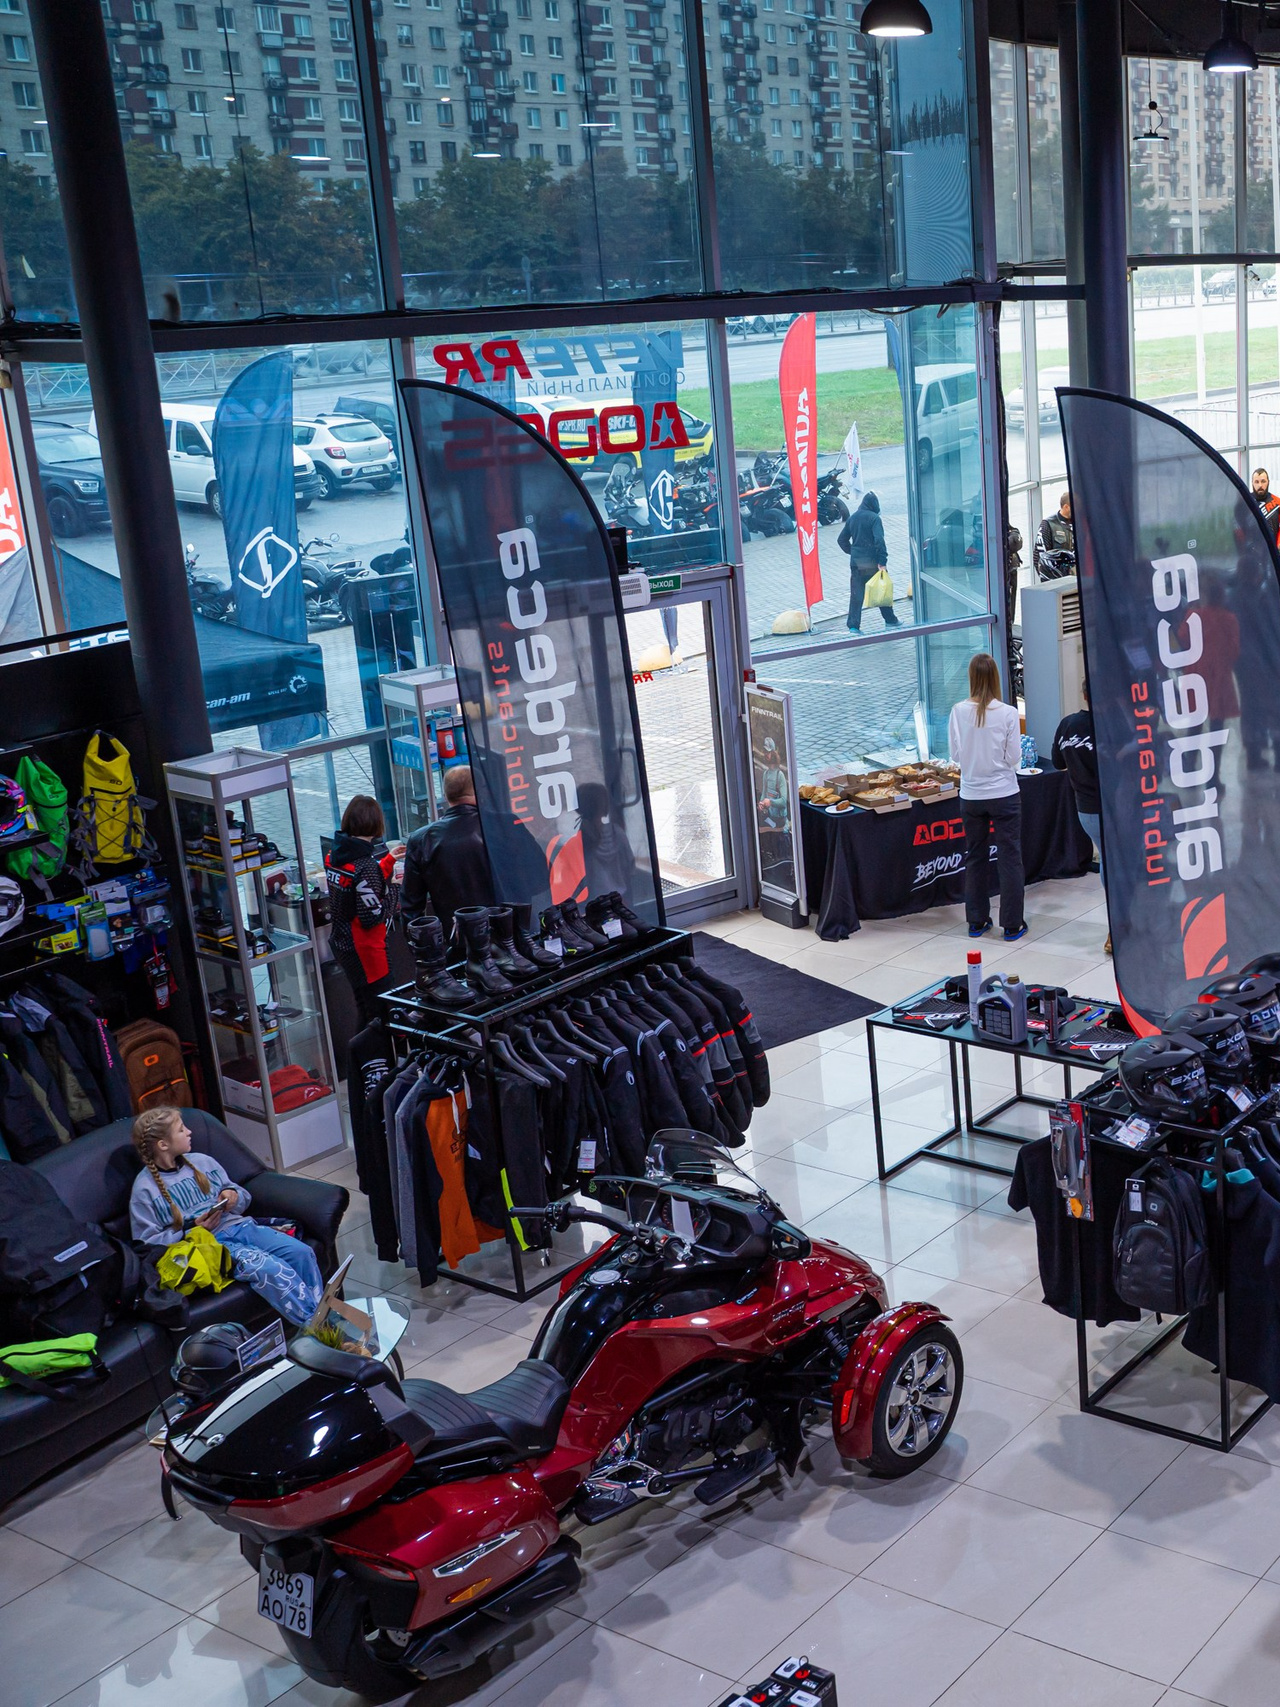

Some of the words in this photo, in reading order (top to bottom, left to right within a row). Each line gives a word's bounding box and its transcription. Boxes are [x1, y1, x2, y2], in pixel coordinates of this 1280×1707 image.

[751, 706, 784, 721] FINNTRAIL
[913, 853, 964, 884] BEYOND
[266, 1567, 305, 1598] 3869
[287, 1605, 307, 1631] 78
